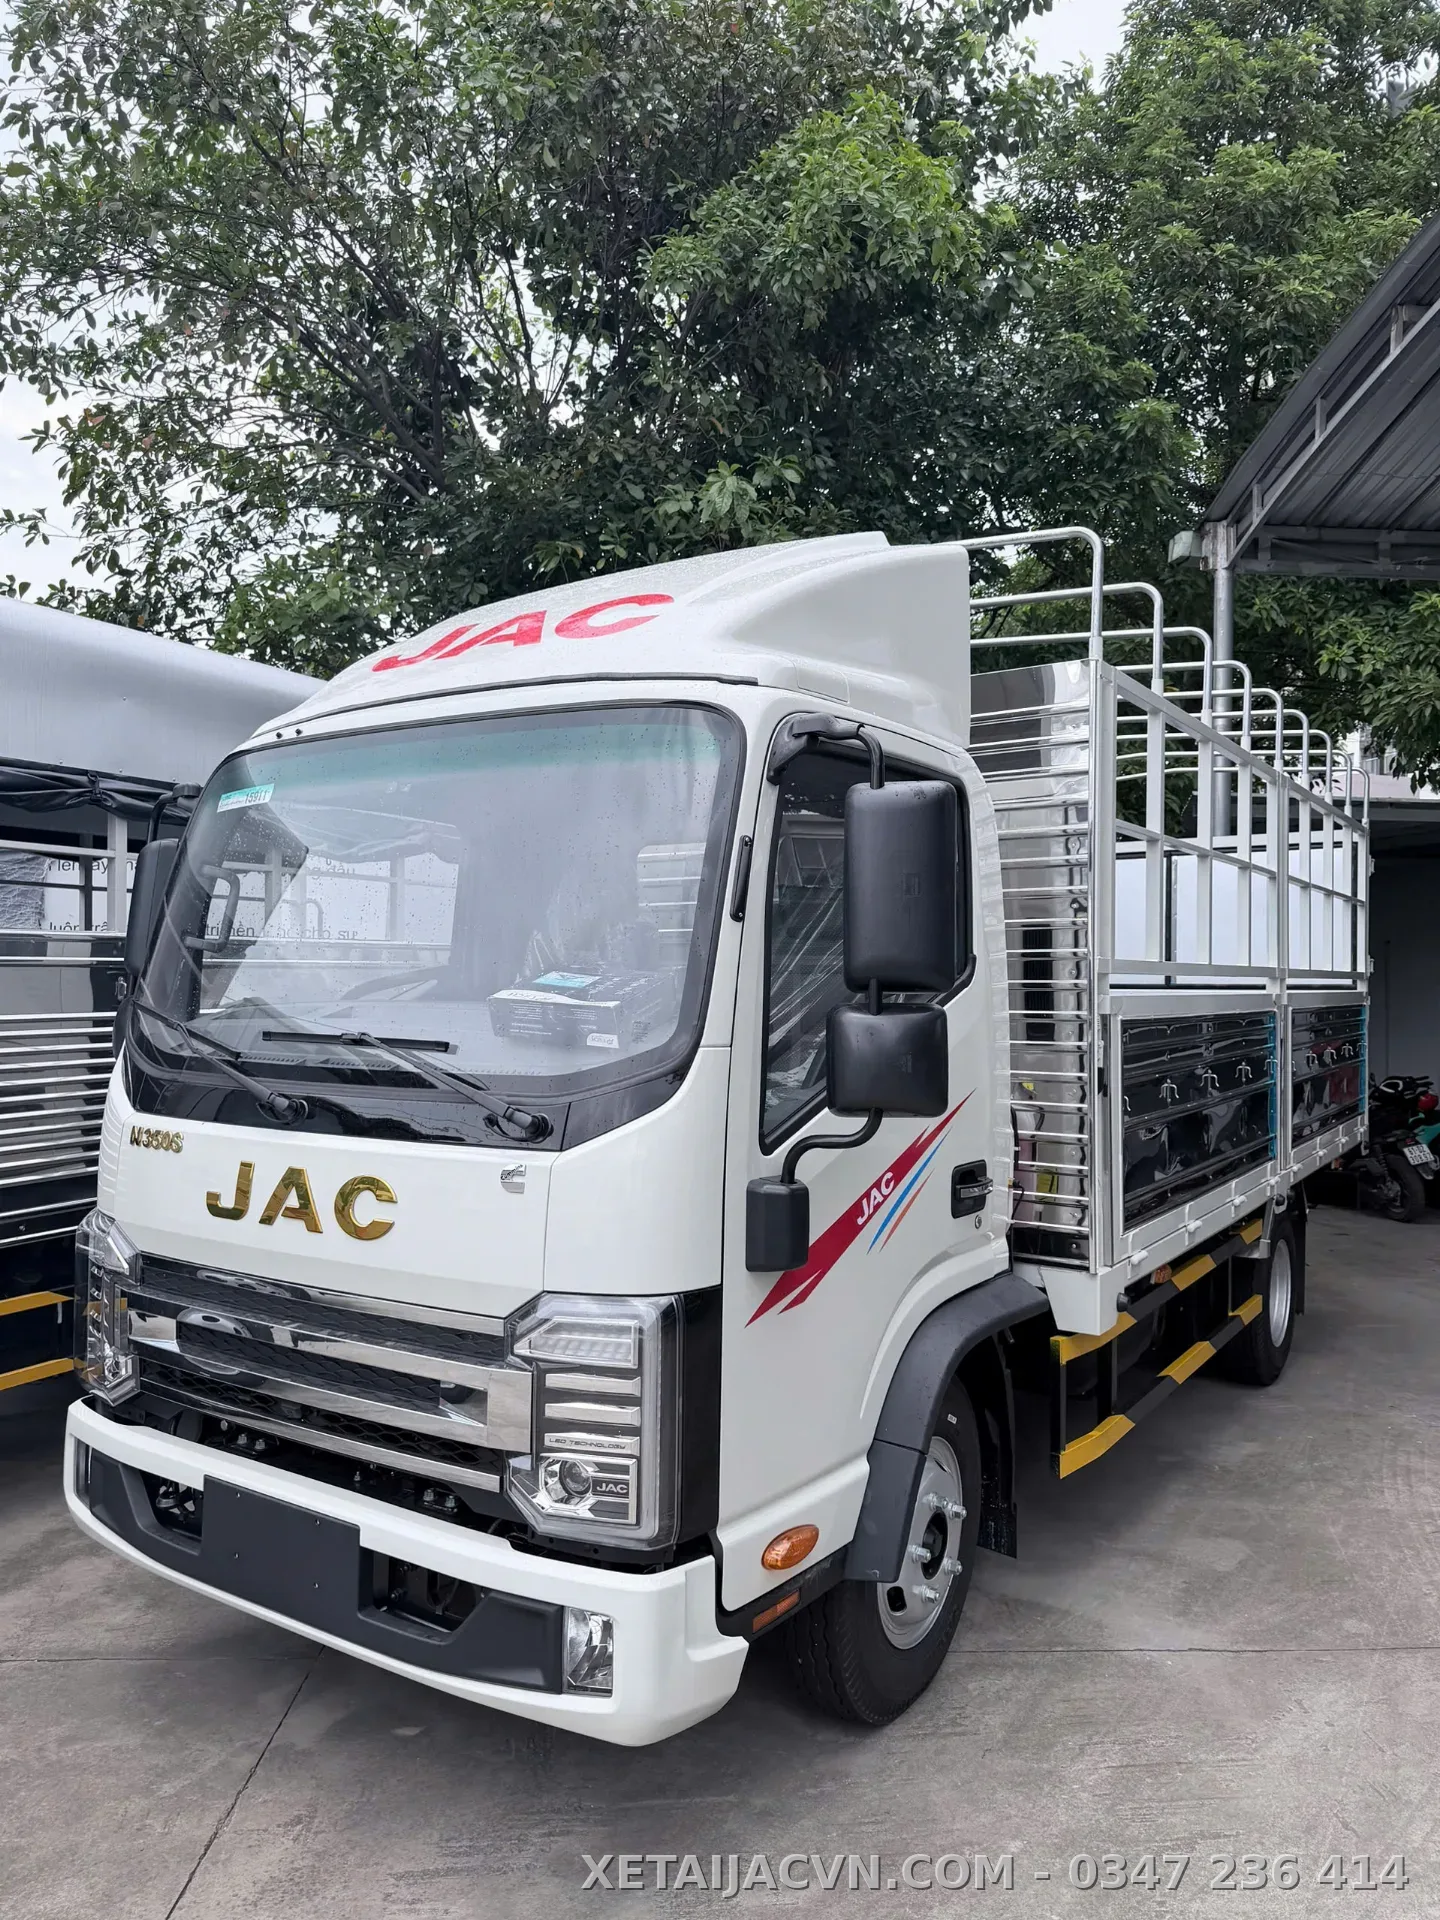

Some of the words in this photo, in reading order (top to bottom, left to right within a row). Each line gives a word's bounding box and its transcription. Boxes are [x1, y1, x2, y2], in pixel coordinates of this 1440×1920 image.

[372, 594, 674, 672] JAC
[129, 1126, 184, 1153] N350S
[206, 1161, 398, 1240] JAC
[857, 1171, 895, 1225] JAC
[569, 1440, 626, 1450] TECHNOLOGY
[596, 1483, 628, 1493] JAC
